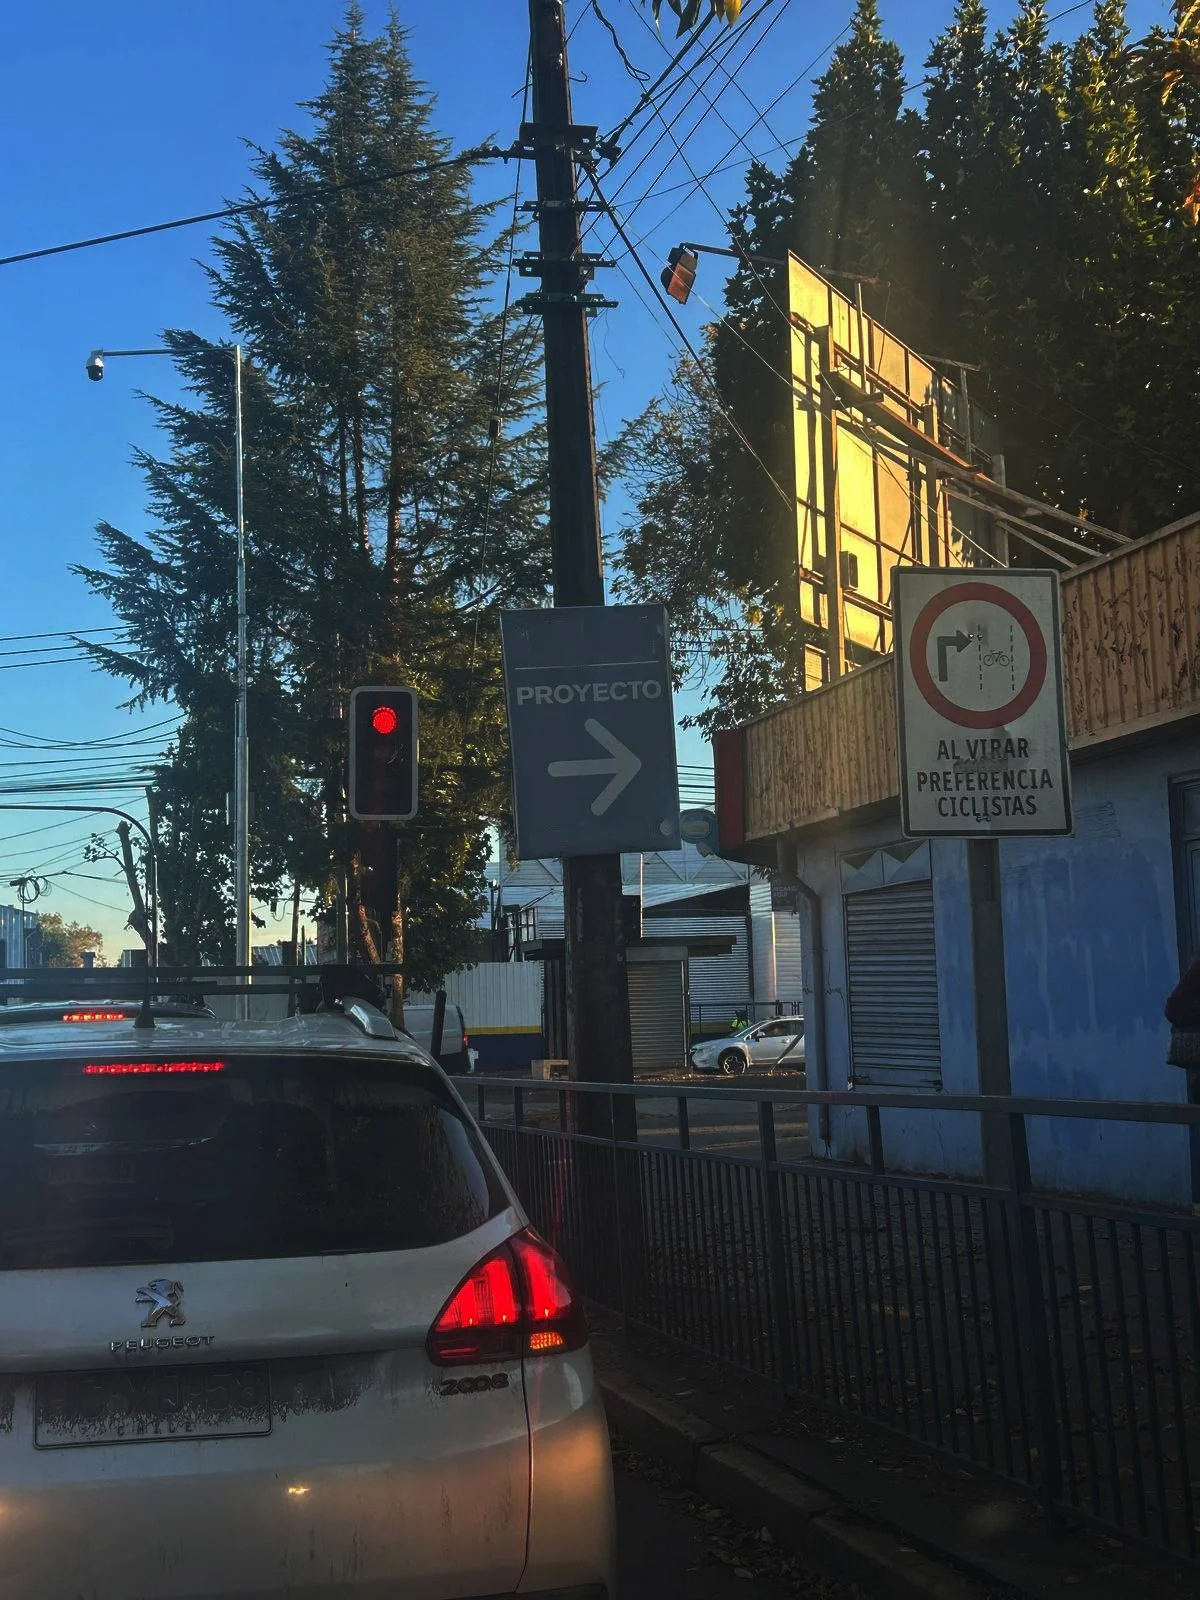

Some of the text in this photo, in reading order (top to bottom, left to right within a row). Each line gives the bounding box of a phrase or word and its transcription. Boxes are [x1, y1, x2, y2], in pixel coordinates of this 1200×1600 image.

[516, 679, 662, 705] PROYECTO
[937, 737, 1029, 761] AL VIRAR
[916, 768, 1054, 792] PREFERENCIA
[937, 795, 1037, 817] CICLISTAS
[110, 1335, 215, 1352] PEUGEOT
[440, 1372, 510, 1397] 2008
